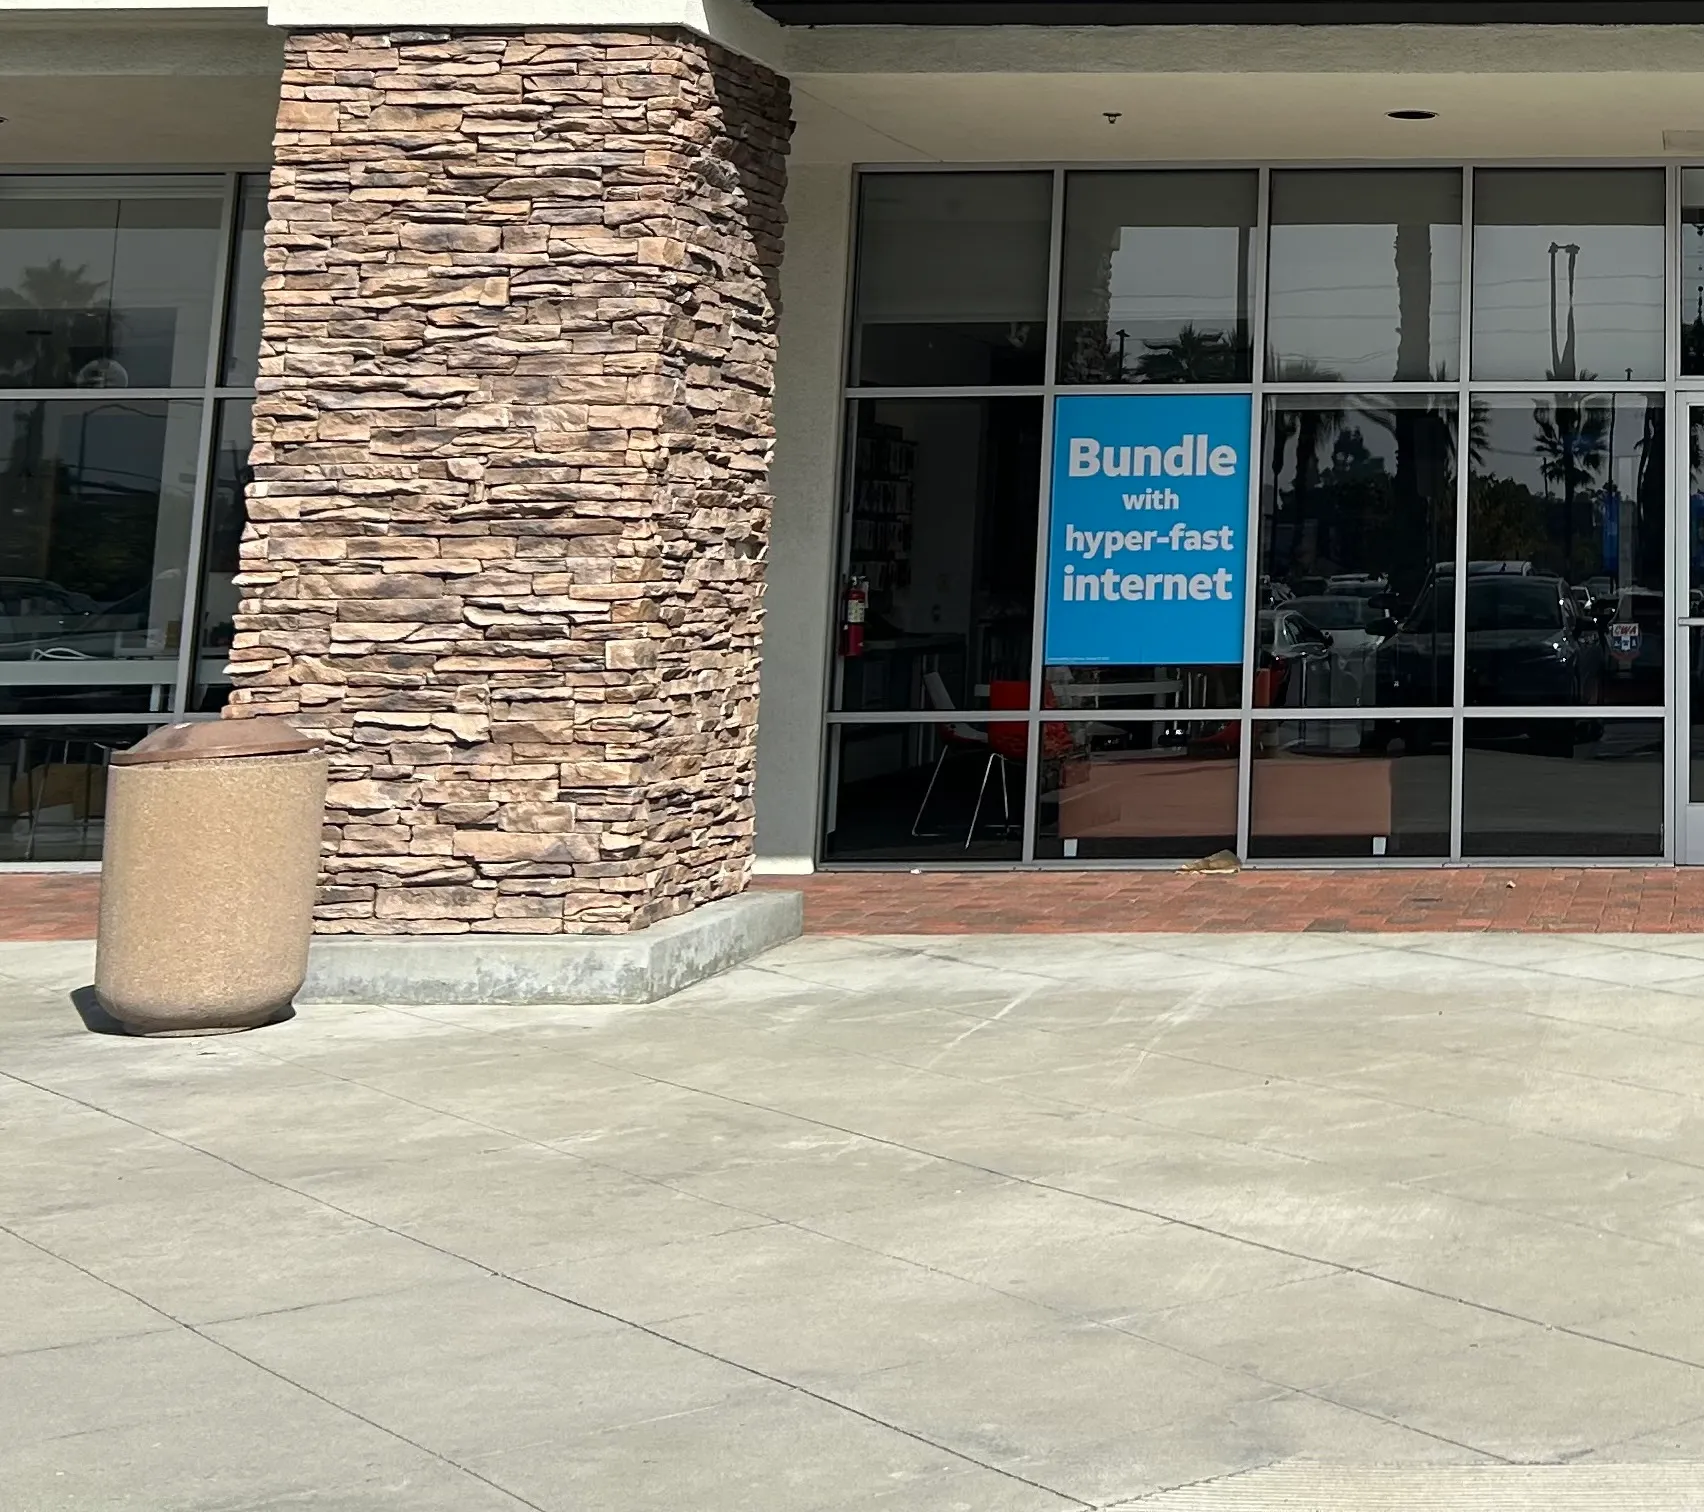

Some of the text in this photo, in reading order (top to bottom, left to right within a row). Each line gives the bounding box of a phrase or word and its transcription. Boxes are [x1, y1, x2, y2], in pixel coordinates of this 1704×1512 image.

[1068, 434, 1238, 478] Bundle
[1122, 488, 1179, 511] with
[1065, 523, 1235, 559] hyper-fast
[1062, 565, 1233, 602] internet
